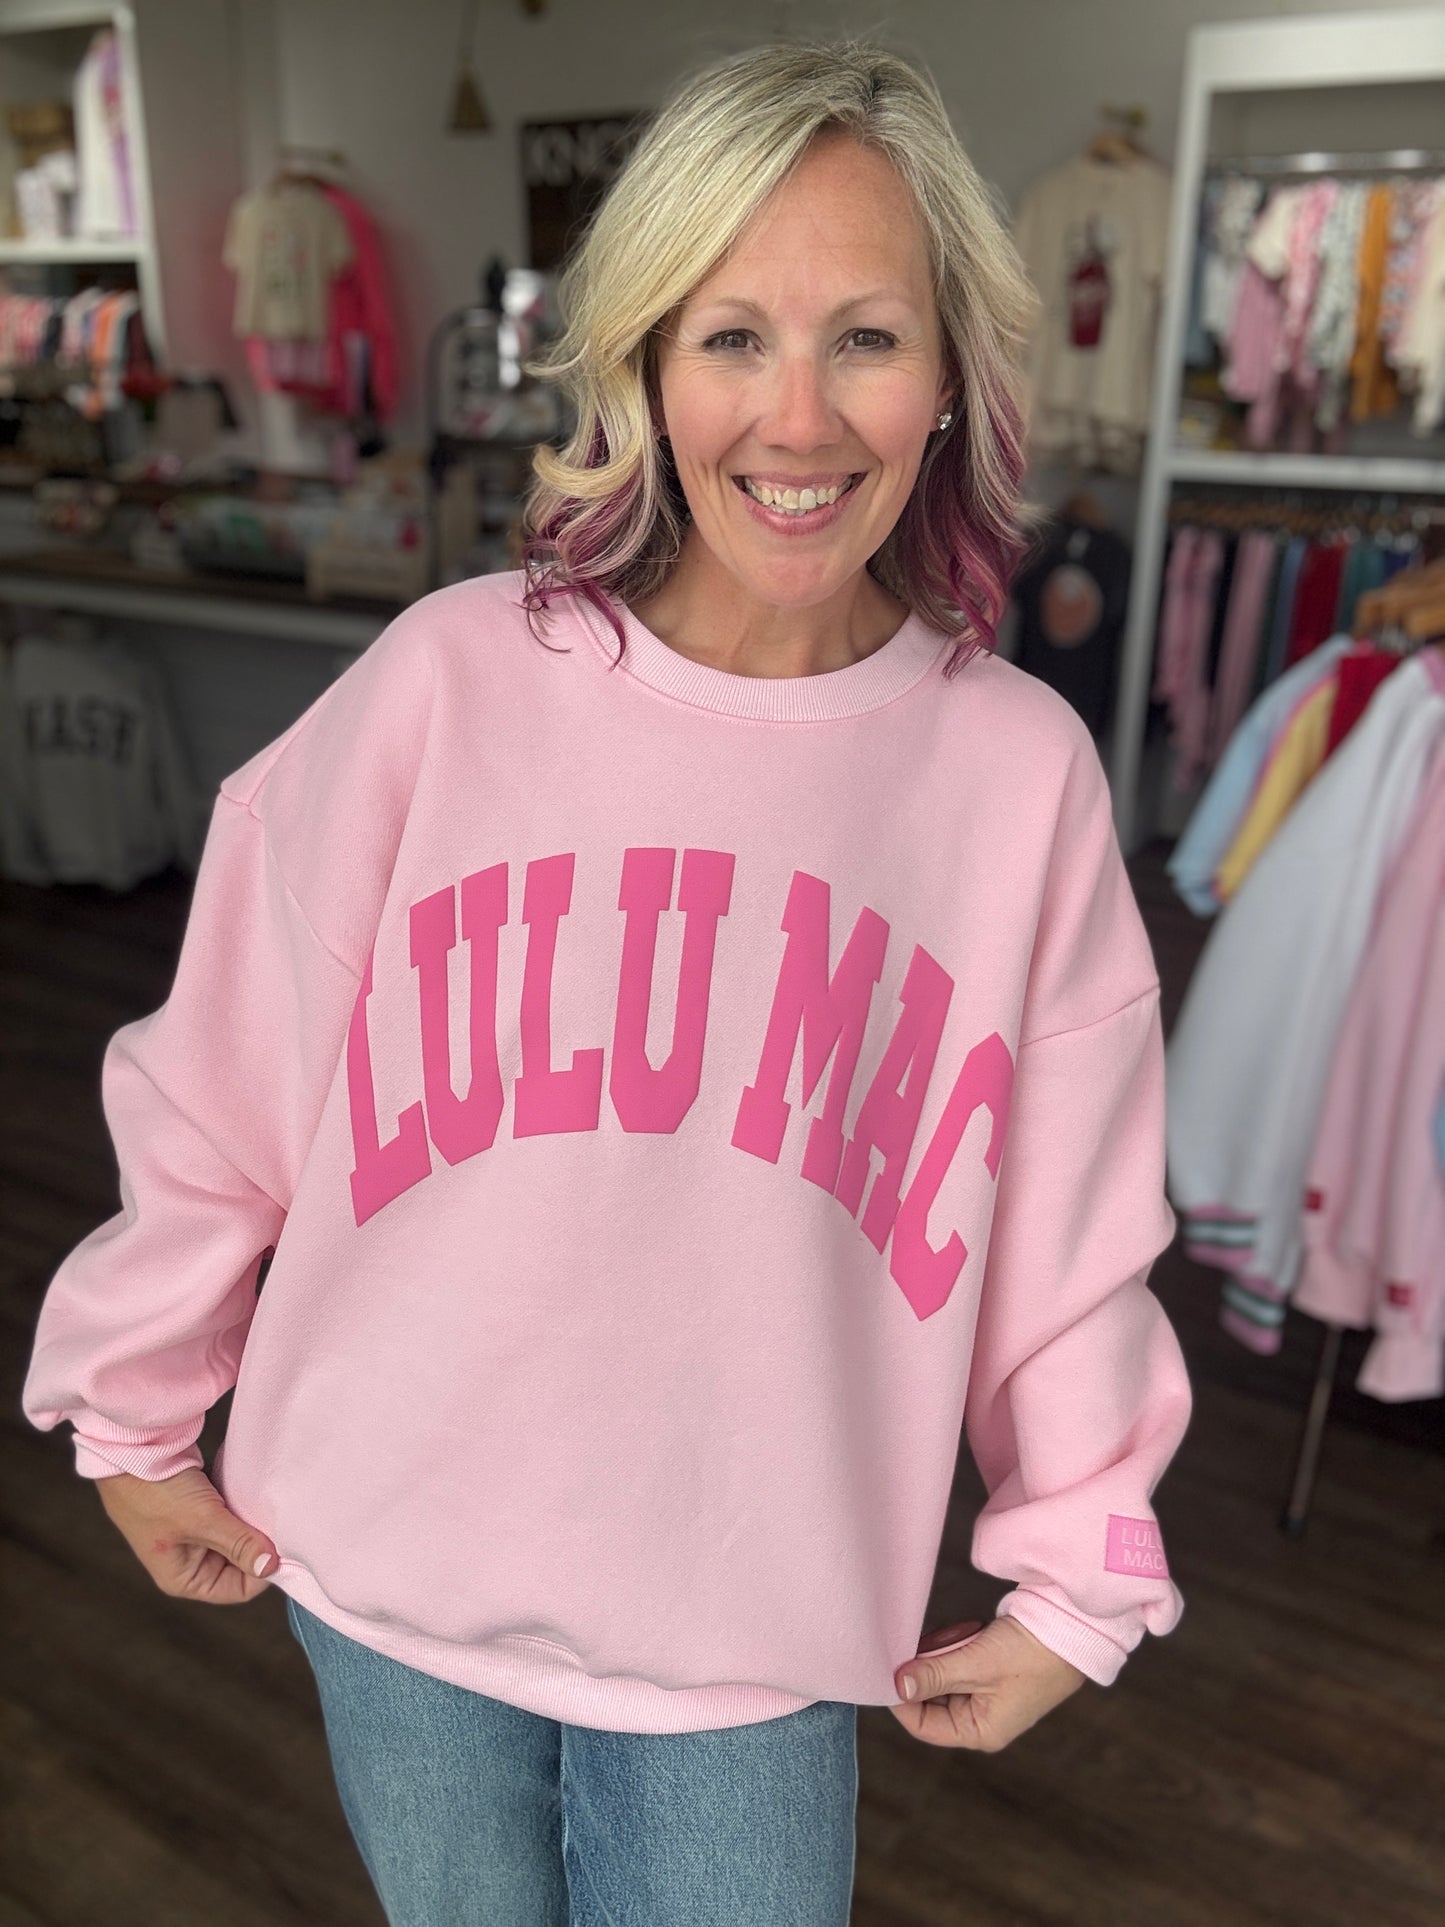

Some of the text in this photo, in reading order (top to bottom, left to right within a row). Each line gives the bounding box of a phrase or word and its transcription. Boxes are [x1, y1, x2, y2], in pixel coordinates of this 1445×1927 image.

[347, 847, 1015, 1321] LULU MAC
[1121, 1527, 1161, 1549] LUL
[1123, 1548, 1164, 1570] MAC
